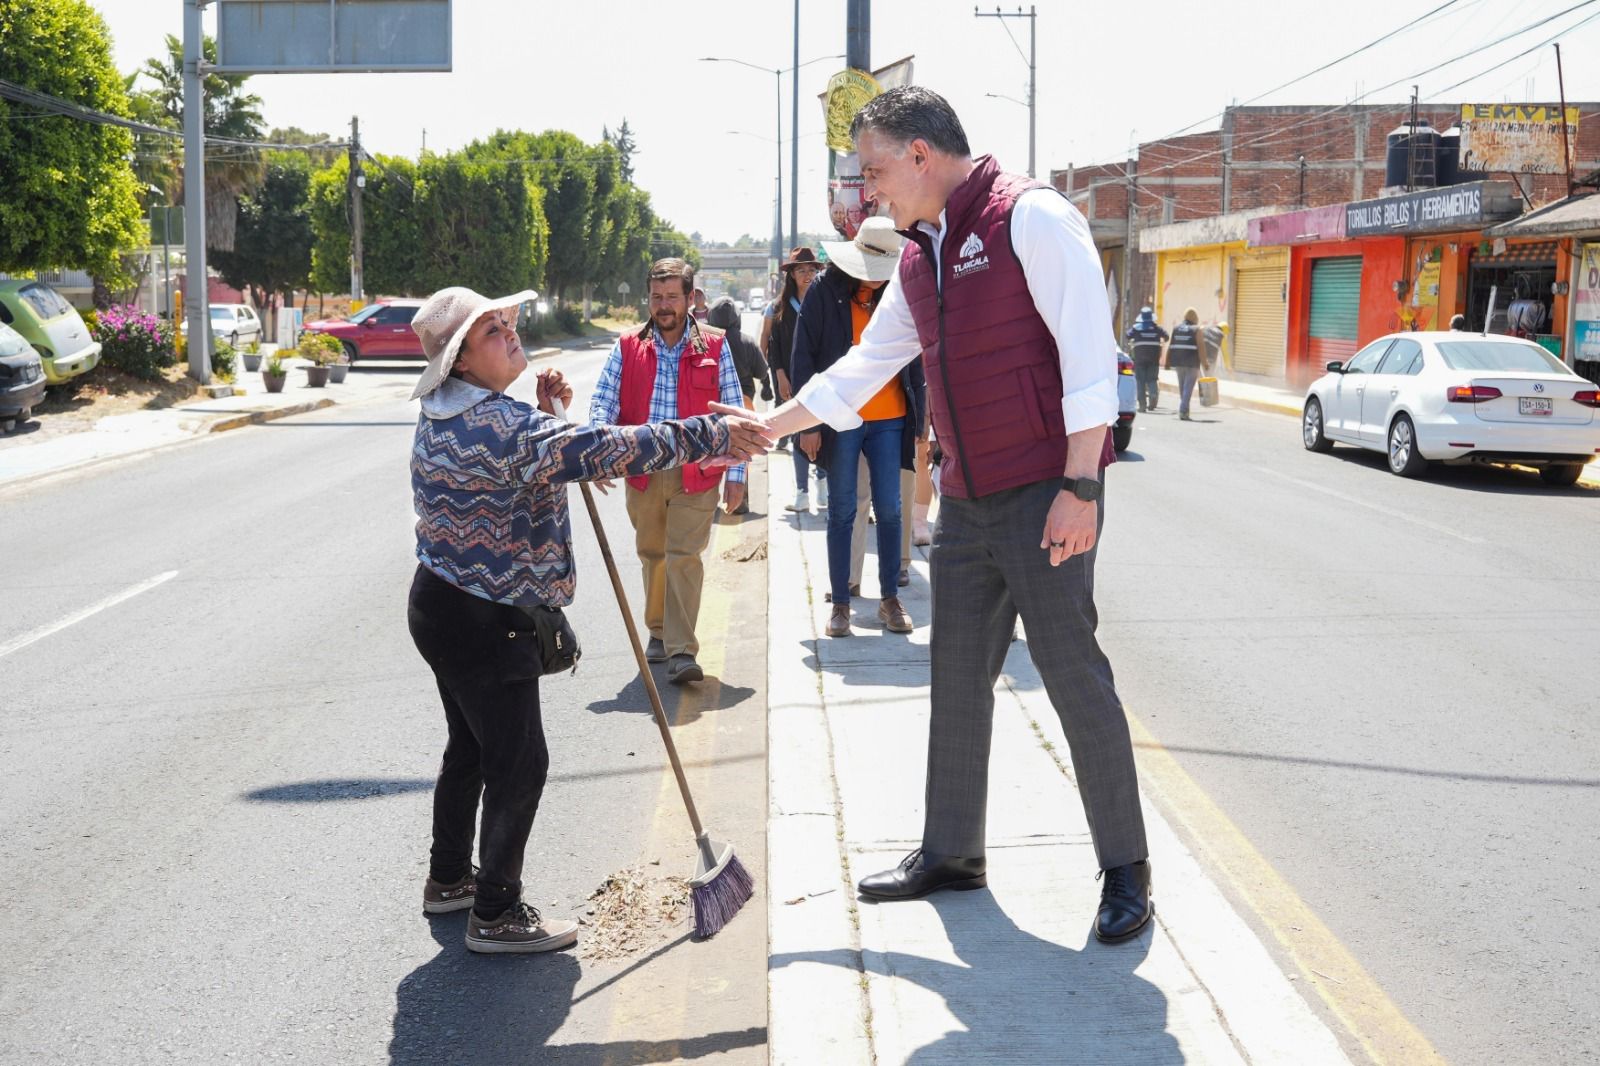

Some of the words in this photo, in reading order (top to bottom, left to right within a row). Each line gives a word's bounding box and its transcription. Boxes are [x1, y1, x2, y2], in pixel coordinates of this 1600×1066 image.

[1347, 206, 1382, 230] TORNILLOS
[1384, 201, 1410, 225] BIRLOS
[1413, 200, 1419, 222] Y
[1422, 190, 1480, 220] HERRAMIENTAS
[953, 255, 989, 273] TLAXCALA
